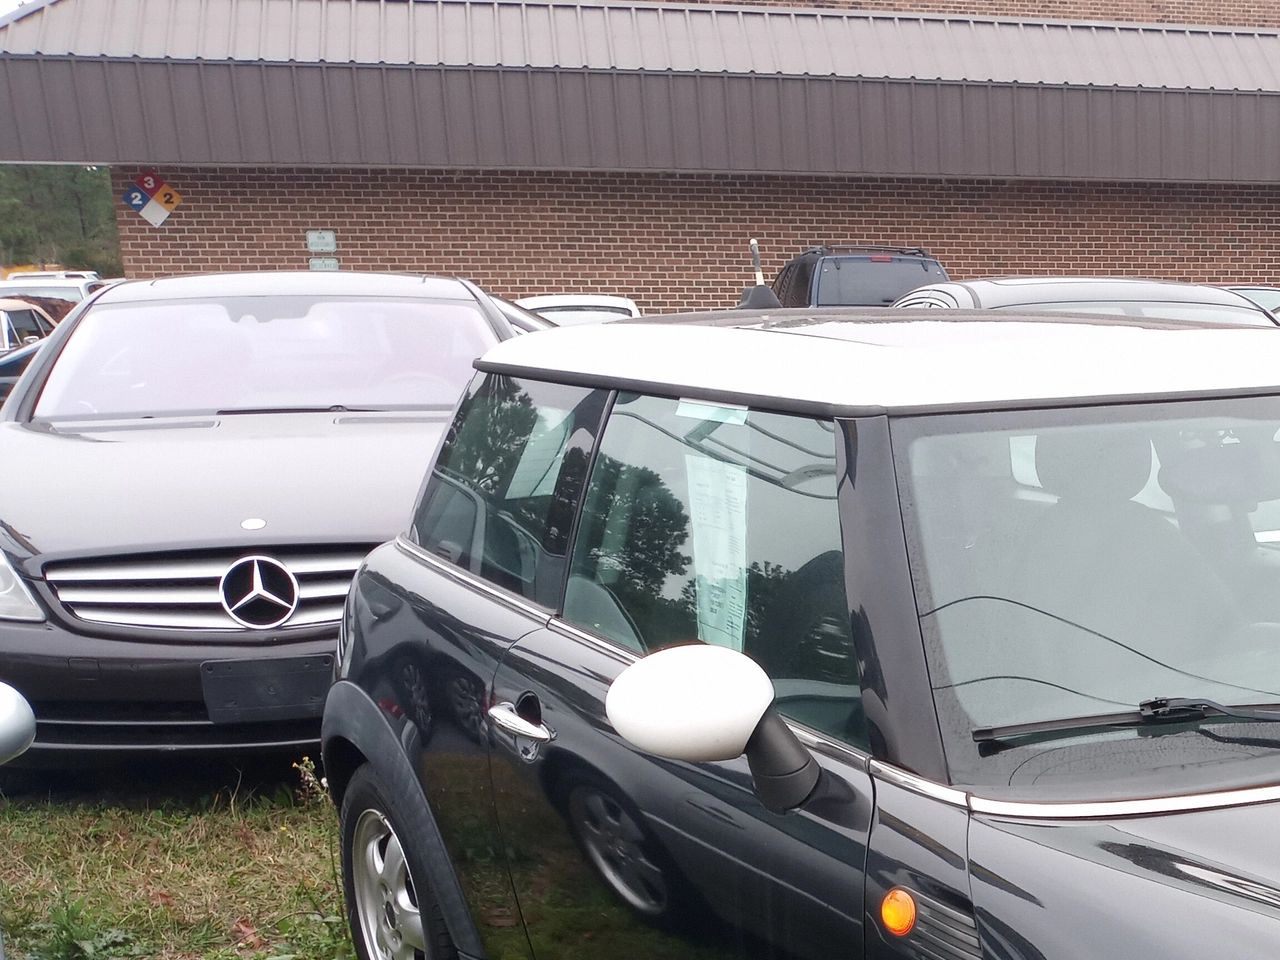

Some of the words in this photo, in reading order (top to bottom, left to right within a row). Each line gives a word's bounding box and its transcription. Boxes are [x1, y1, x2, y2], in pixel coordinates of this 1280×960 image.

[143, 175, 155, 189] 3
[131, 191, 143, 205] 2
[163, 192, 175, 205] 2
